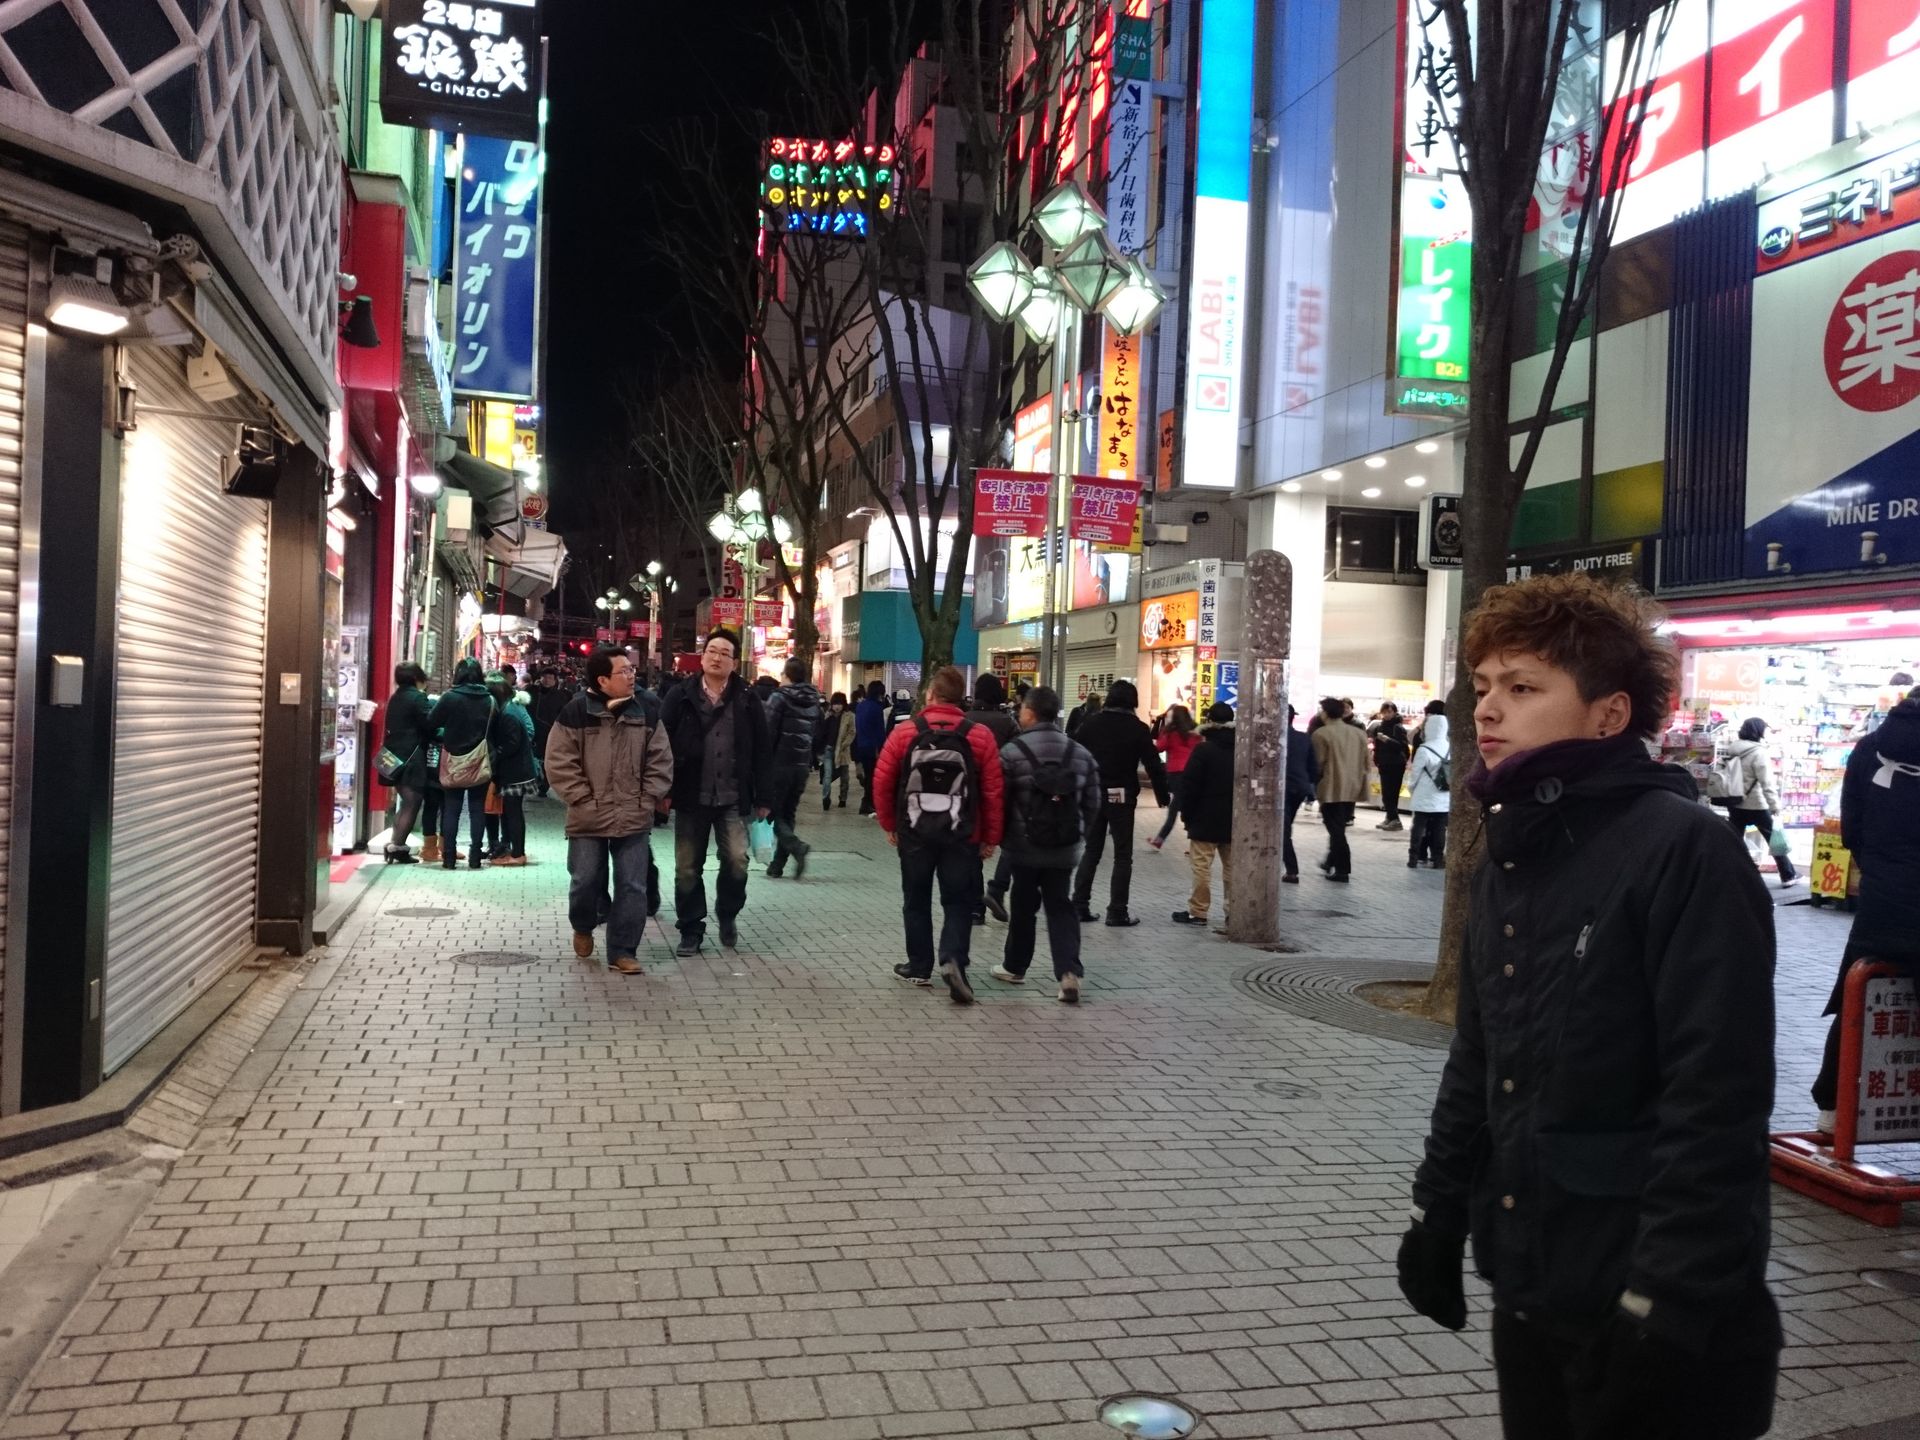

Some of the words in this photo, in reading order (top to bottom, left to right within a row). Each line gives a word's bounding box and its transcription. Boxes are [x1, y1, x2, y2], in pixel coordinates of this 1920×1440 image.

[460, 181, 500, 375] バイオリン
[1416, 249, 1455, 360] レイク
[1198, 278, 1224, 366] LABI
[1113, 333, 1132, 388] 岐うどん
[1435, 361, 1463, 377] B2F
[1106, 394, 1133, 469] はなまる
[993, 494, 1032, 513] 禁止
[1081, 500, 1119, 519] 禁止
[1826, 502, 1881, 528] MINE
[1573, 555, 1603, 572] DUTY
[1605, 551, 1634, 568] FREE
[1200, 579, 1216, 643] 歯科医院
